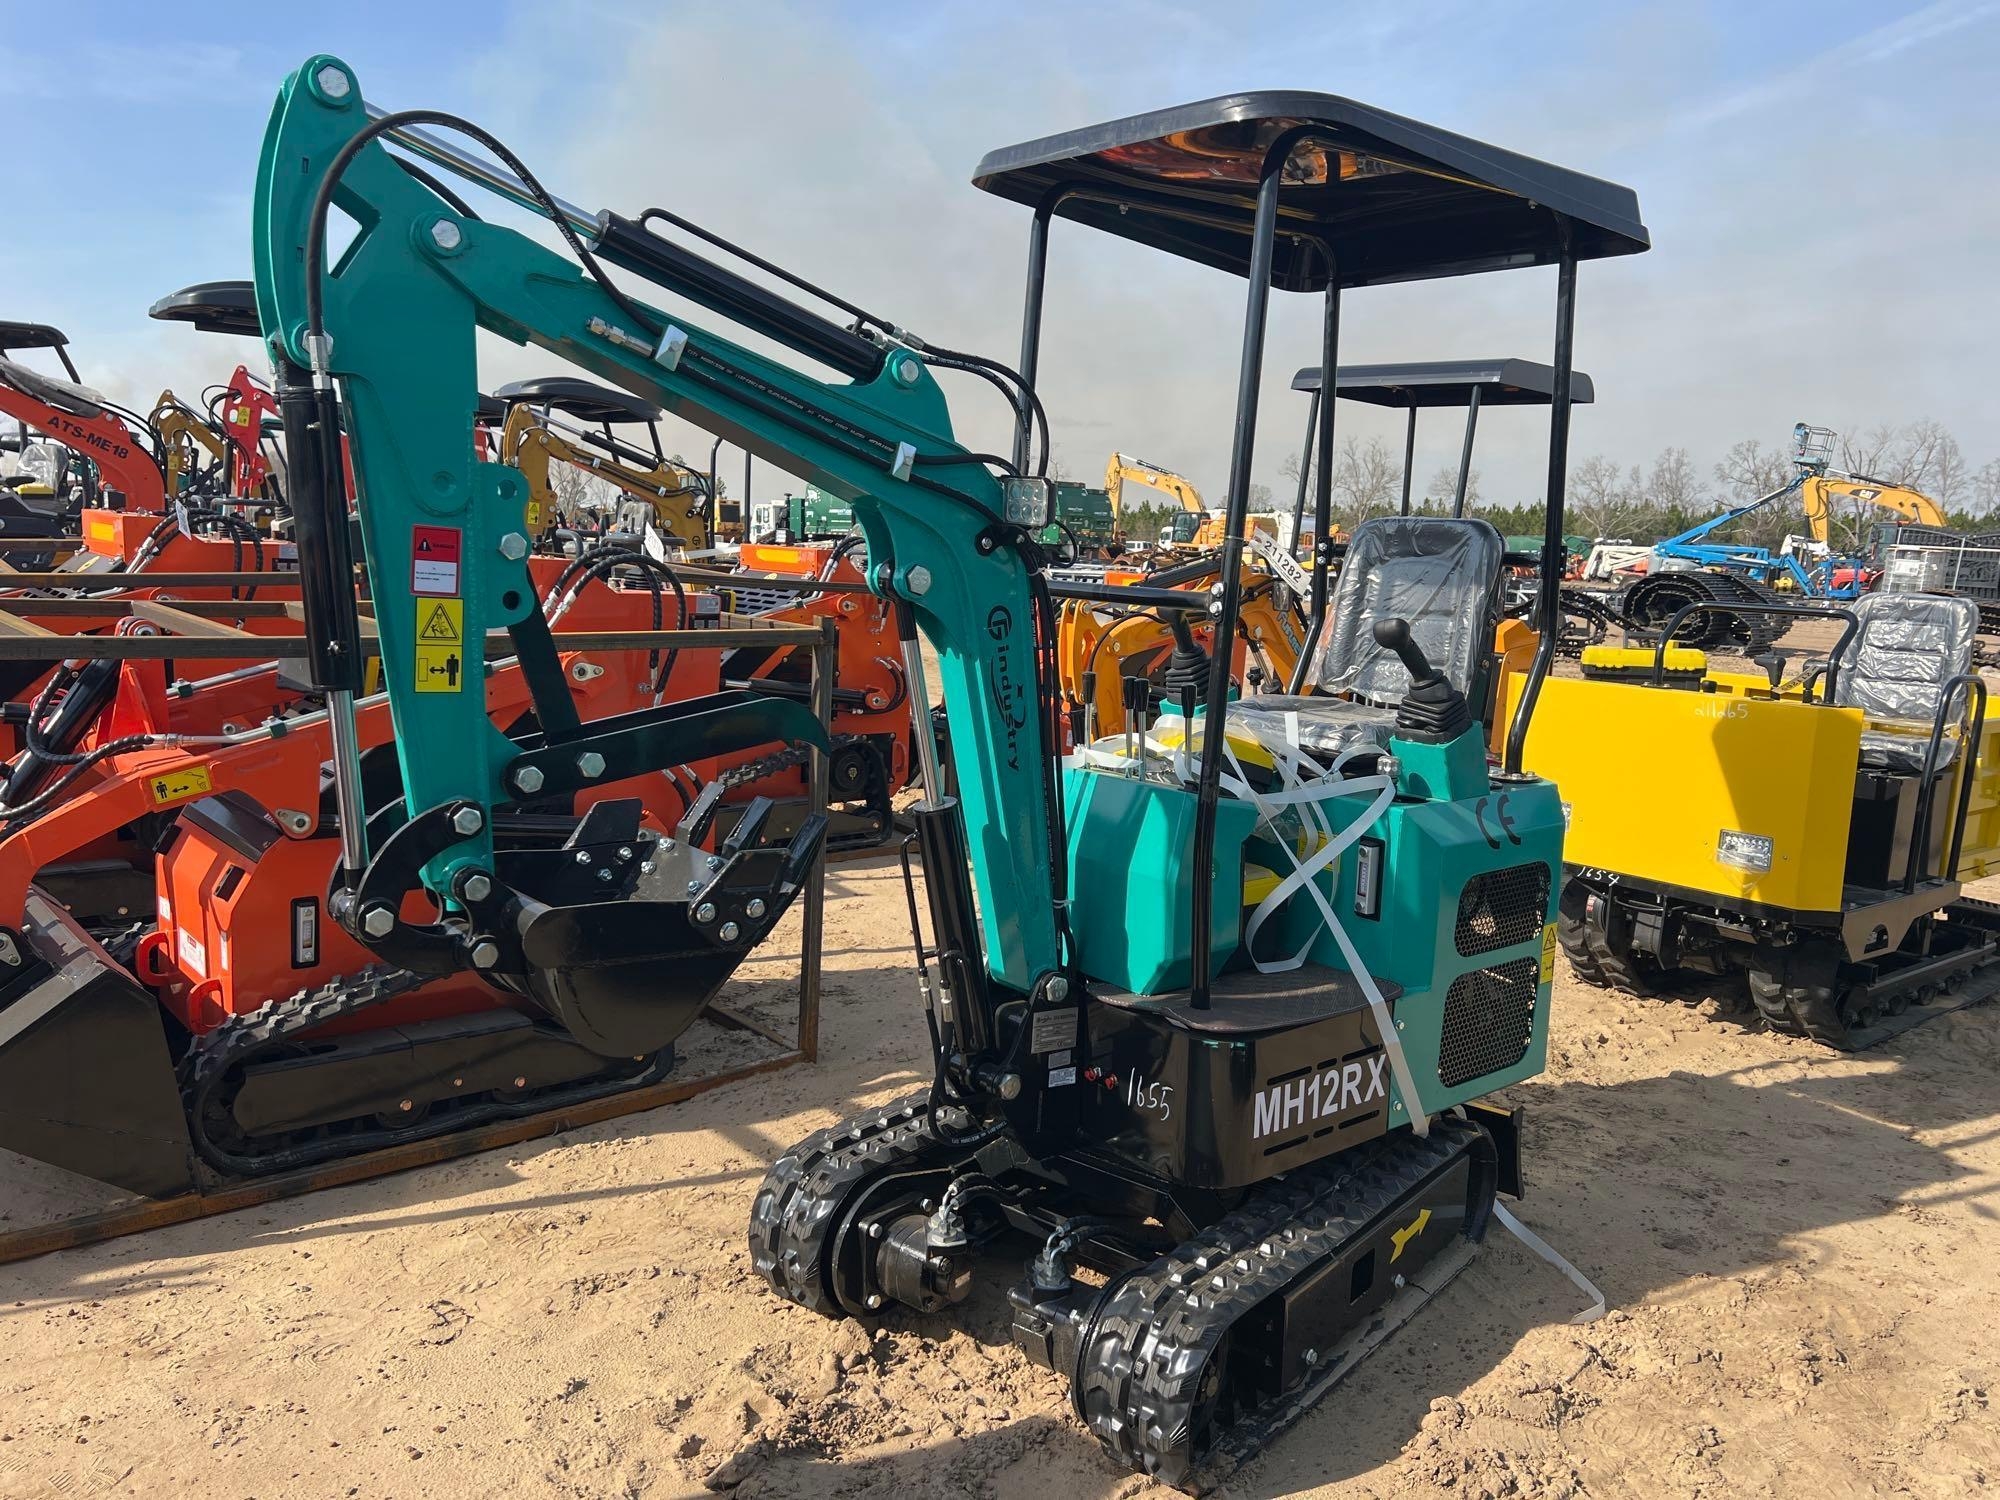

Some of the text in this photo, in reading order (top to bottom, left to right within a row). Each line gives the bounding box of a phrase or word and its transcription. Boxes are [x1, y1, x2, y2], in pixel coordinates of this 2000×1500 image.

[47, 416, 129, 459] ATS-ME18
[1263, 538, 1304, 584] 211282
[1475, 794, 1522, 850] CE
[1577, 866, 1620, 887] 1654
[1127, 1067, 1174, 1121] 1655
[1253, 1054, 1387, 1139] MH12RX
